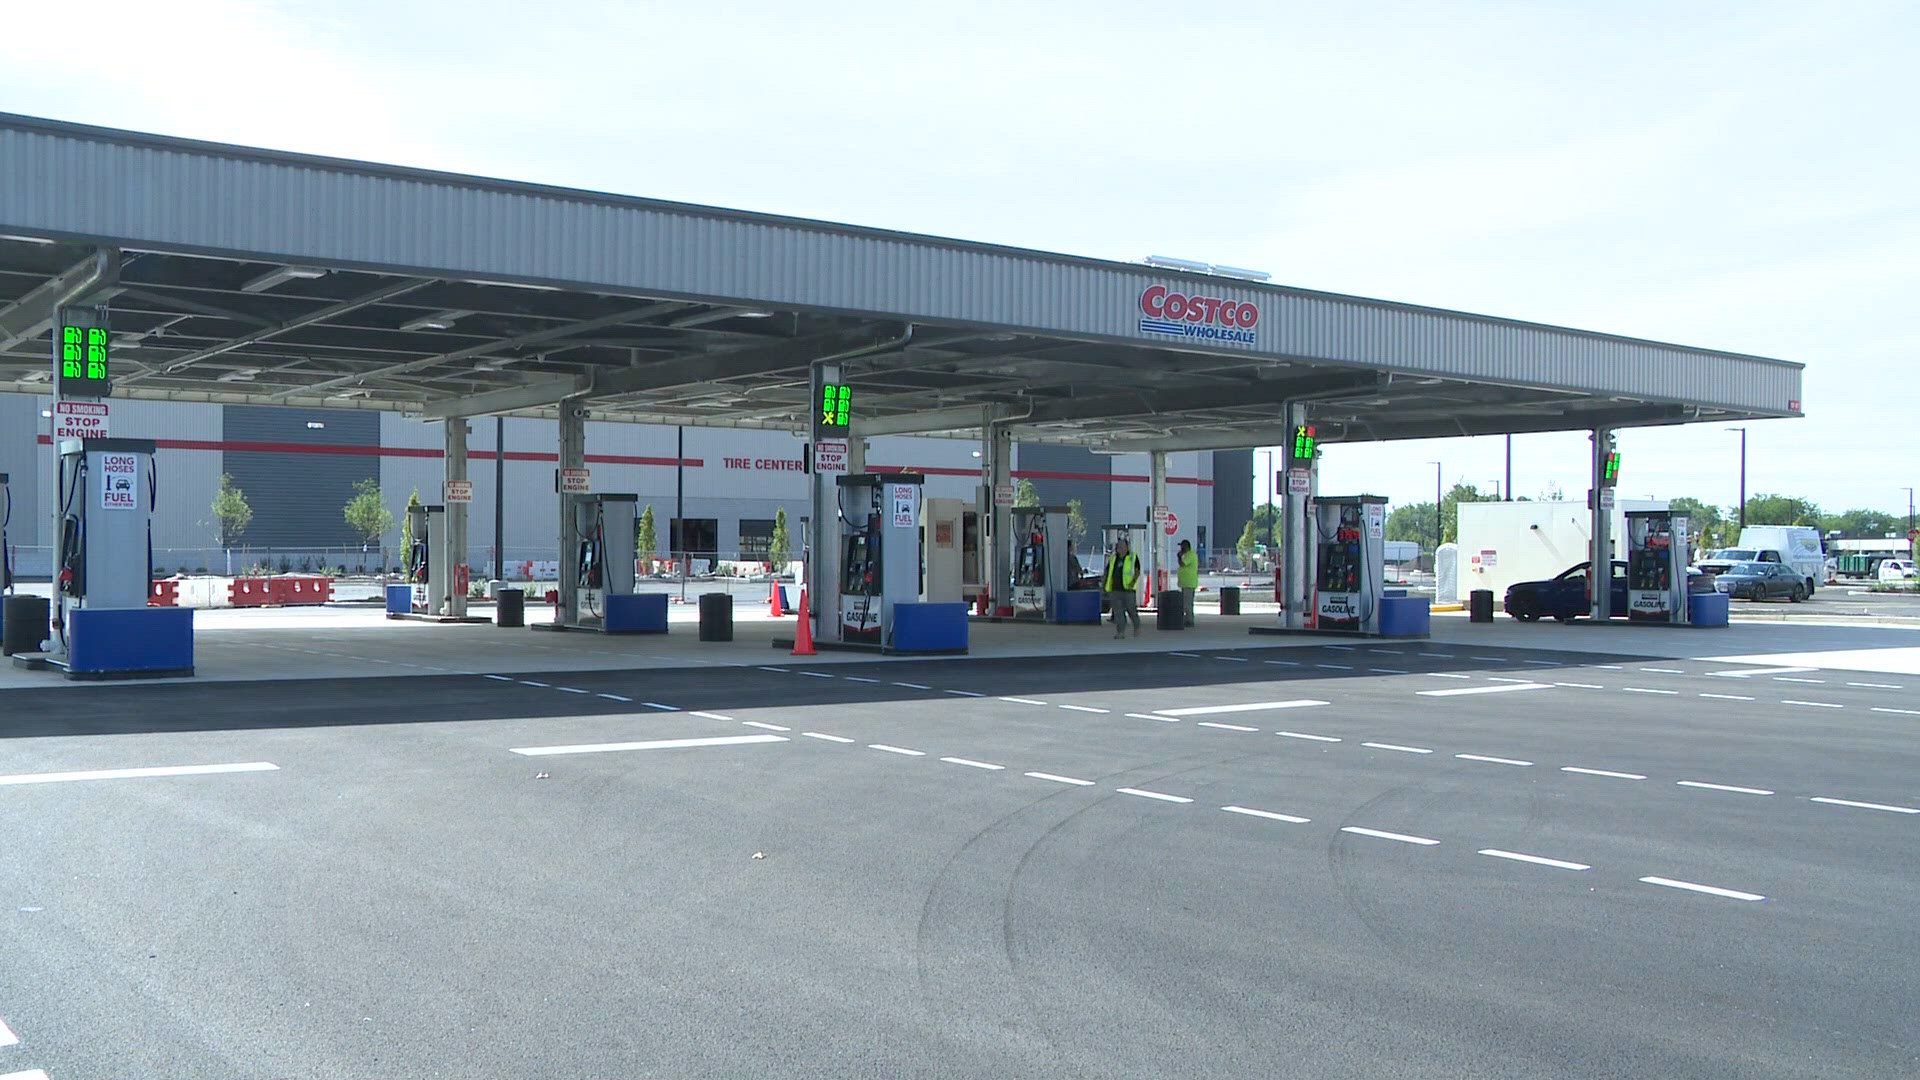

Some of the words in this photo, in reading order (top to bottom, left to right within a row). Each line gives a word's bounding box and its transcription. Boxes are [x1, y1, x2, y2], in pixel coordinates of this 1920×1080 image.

[1141, 285, 1259, 329] COSTCO
[1183, 325, 1255, 343] WHOLESALE
[60, 403, 71, 413] NO
[72, 404, 106, 415] SMOKING
[65, 416, 101, 427] STOP
[57, 427, 107, 439] ENGINE
[104, 456, 135, 465] LONG
[820, 454, 842, 462] STOP
[104, 465, 135, 473] HOSES
[723, 458, 751, 469] TIRE
[755, 459, 803, 472] CENTER
[816, 462, 846, 471] ENGINE
[104, 492, 134, 502] FUEL
[895, 514, 913, 522] FUEL
